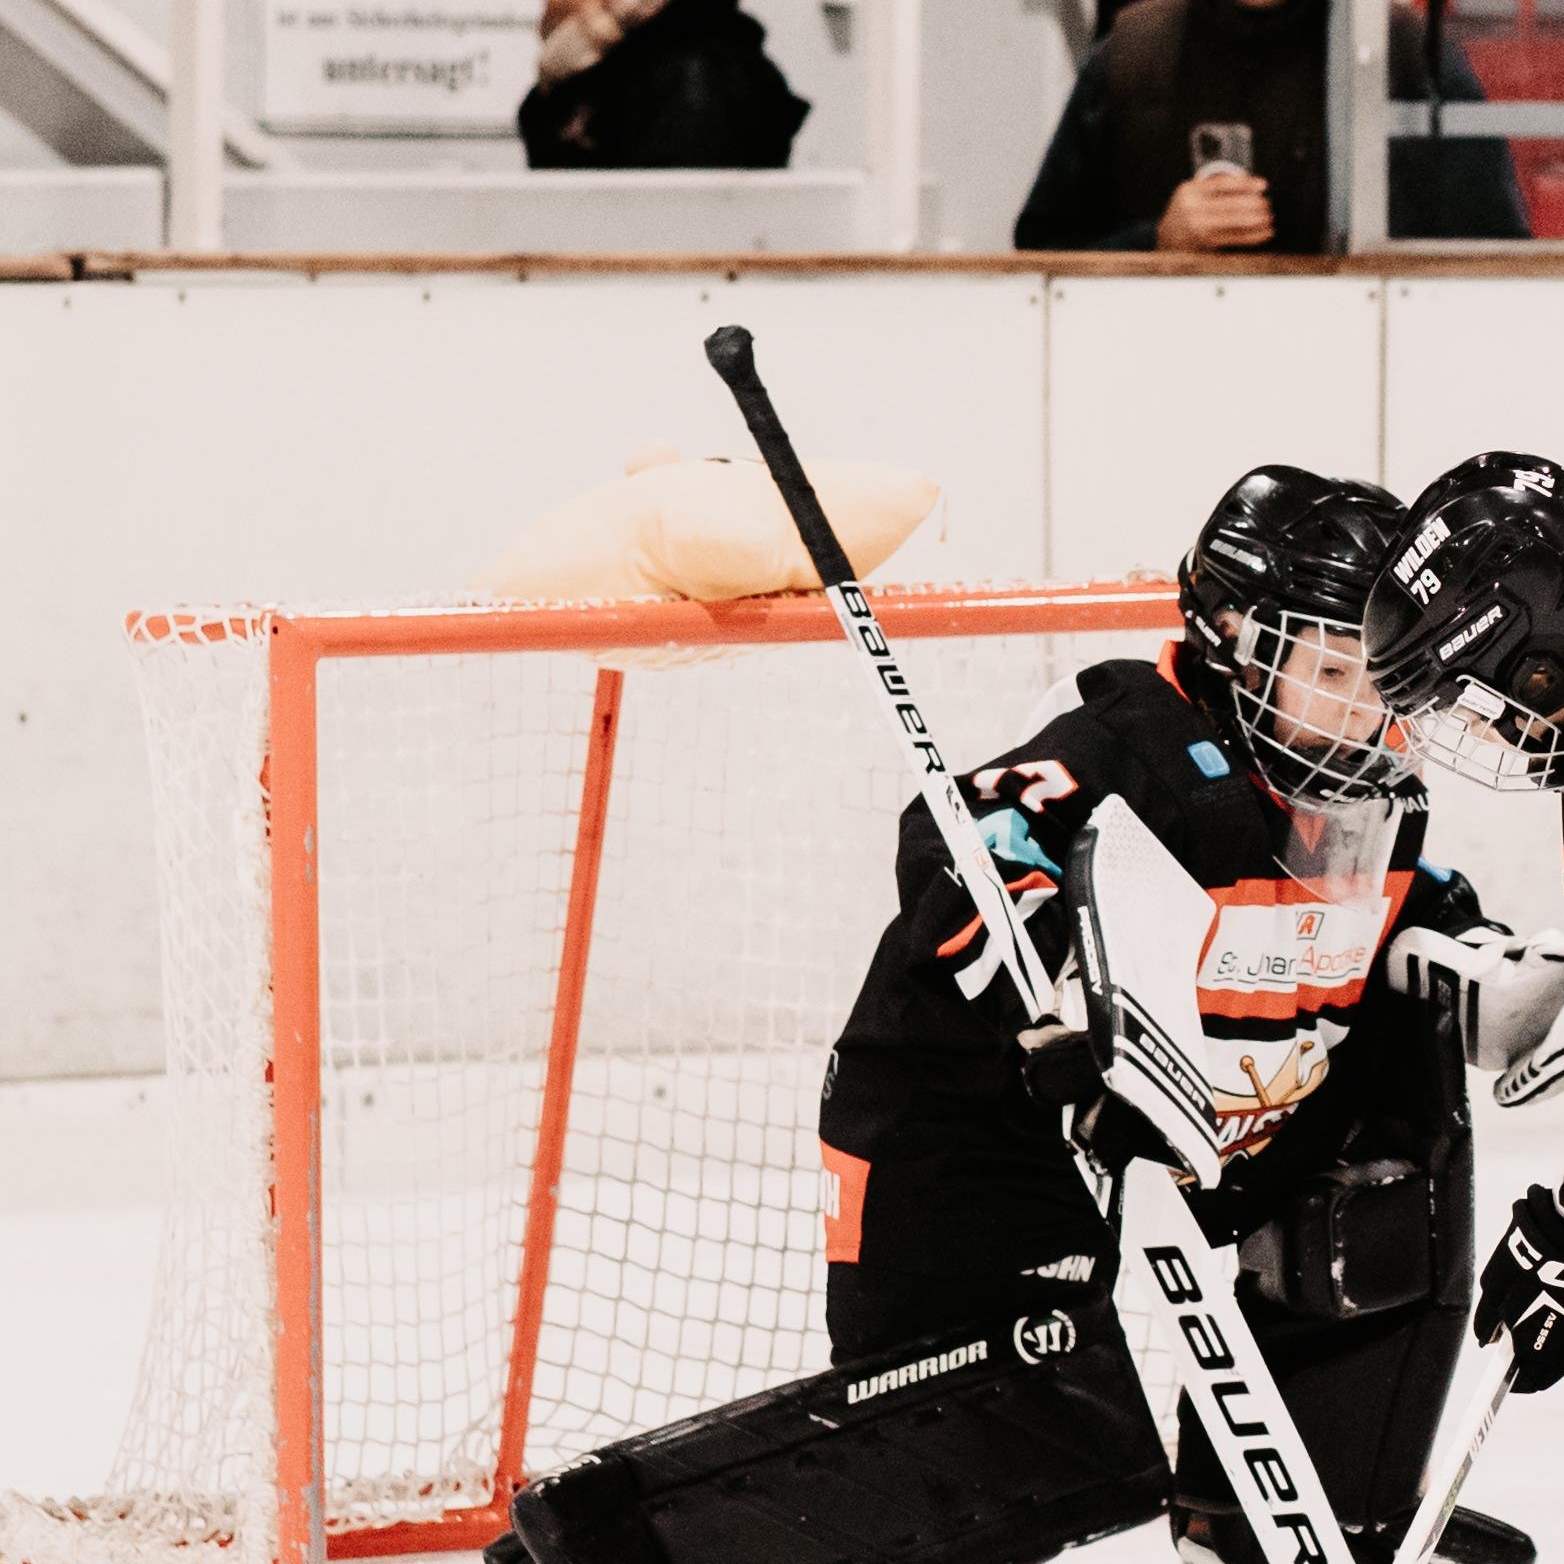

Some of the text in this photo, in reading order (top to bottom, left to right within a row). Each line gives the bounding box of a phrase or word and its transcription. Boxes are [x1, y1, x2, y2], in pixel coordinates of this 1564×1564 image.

[1393, 516, 1452, 586] WILDEN
[1410, 568, 1443, 605] 79
[1438, 604, 1504, 662] BAUER
[840, 585, 946, 775] BAUER
[847, 1339, 989, 1406] WARRIOR
